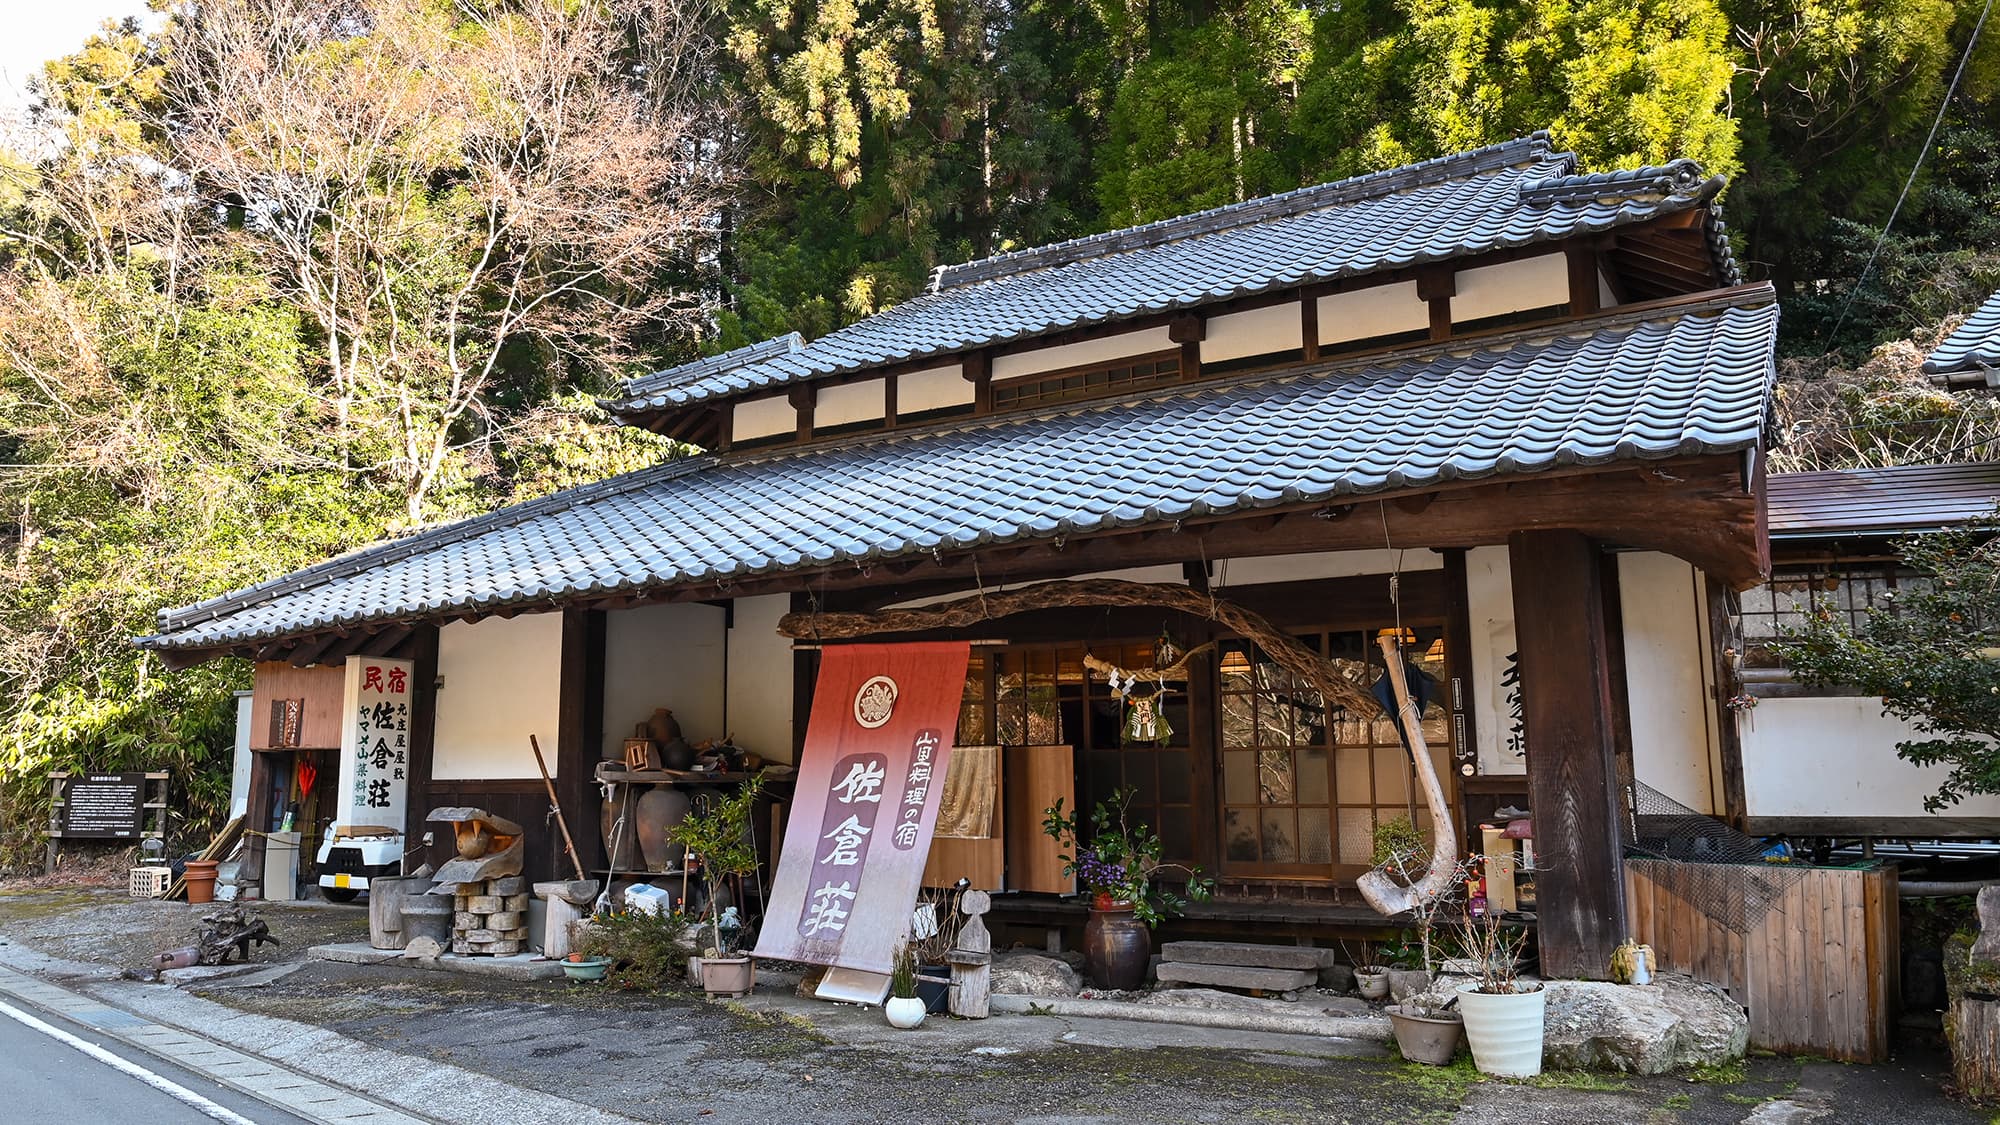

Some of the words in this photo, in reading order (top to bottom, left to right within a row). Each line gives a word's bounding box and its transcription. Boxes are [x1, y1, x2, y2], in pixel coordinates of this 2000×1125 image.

[363, 666, 408, 694] 民宿
[367, 701, 395, 809] 佐倉荘
[895, 732, 938, 847] 山里料理の宿
[805, 760, 886, 938] 佐倉荘
